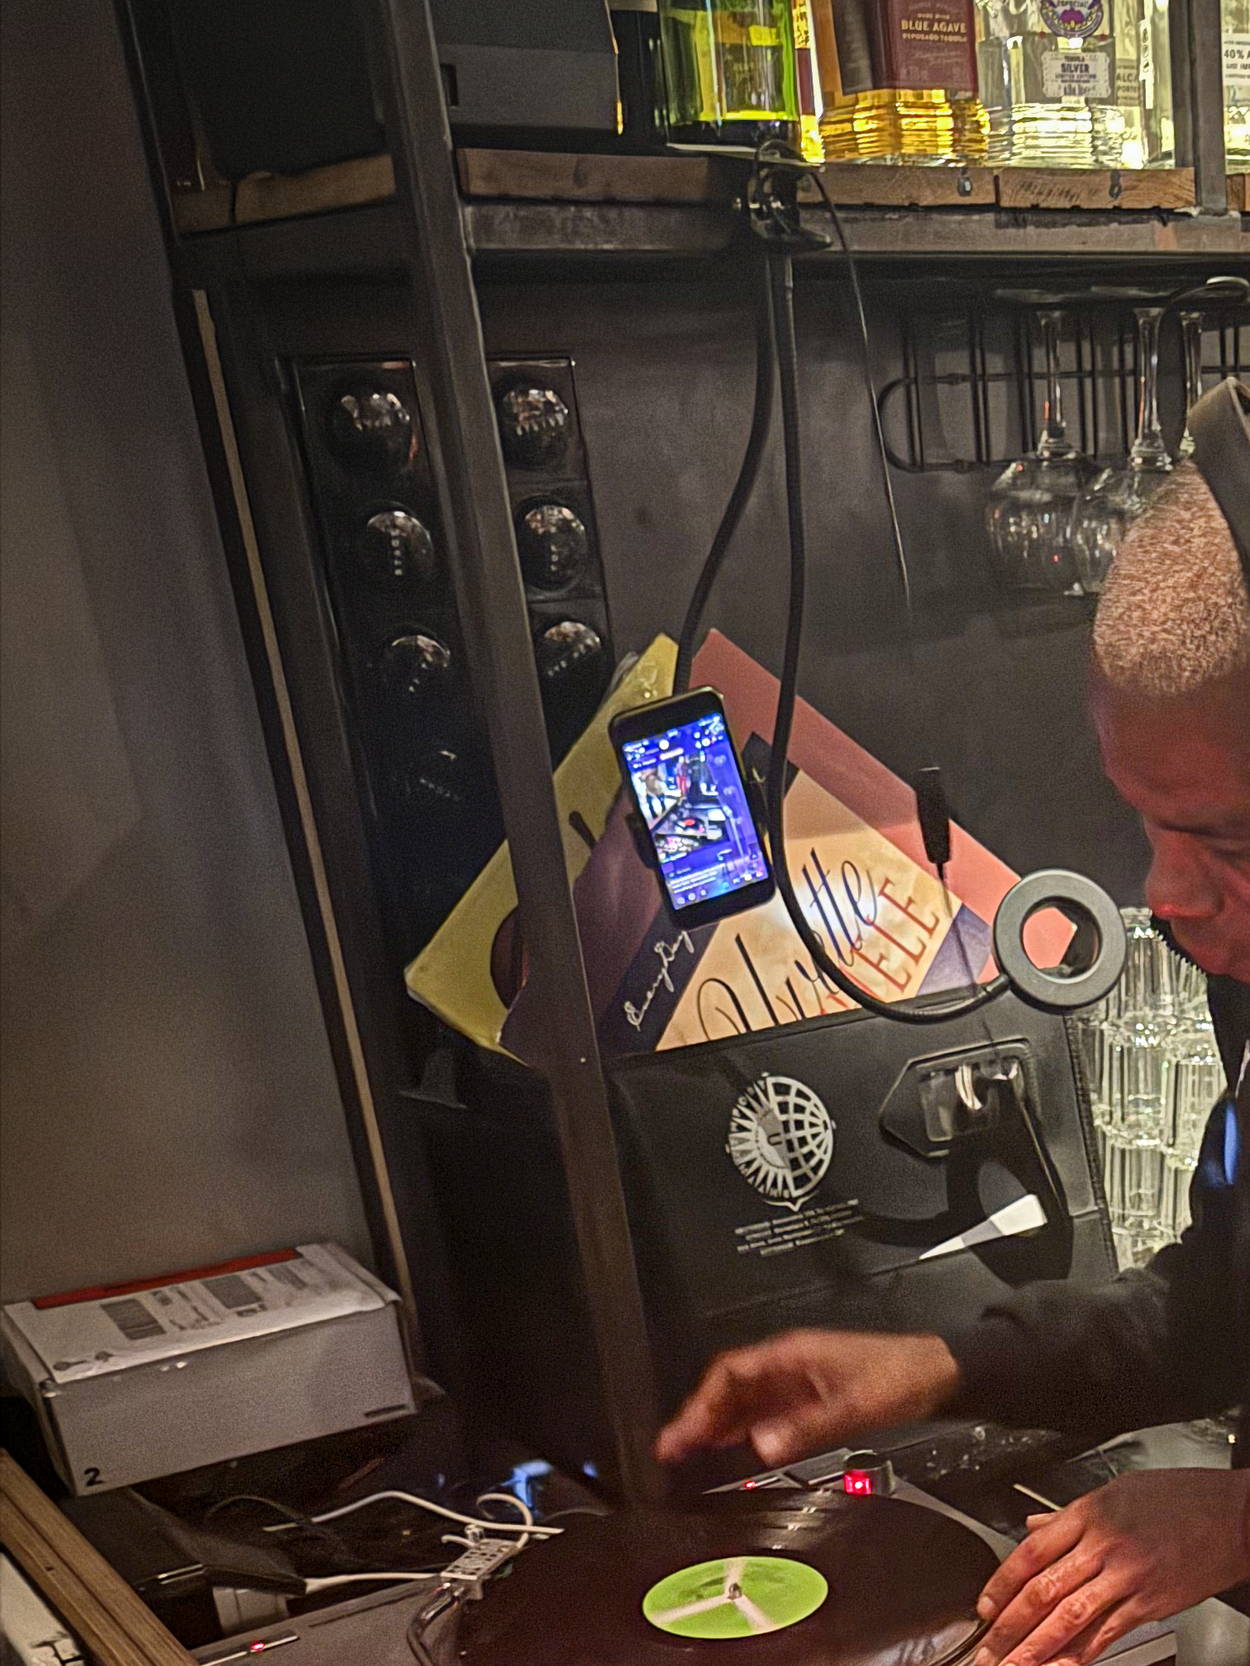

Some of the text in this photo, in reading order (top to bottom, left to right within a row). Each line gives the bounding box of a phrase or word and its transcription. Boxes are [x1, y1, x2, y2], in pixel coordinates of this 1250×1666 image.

[901, 19, 968, 34] BLUE AGAVE
[1223, 49, 1245, 60] 40%
[1060, 63, 1090, 74] SILVER
[84, 1467, 105, 1487] 2
